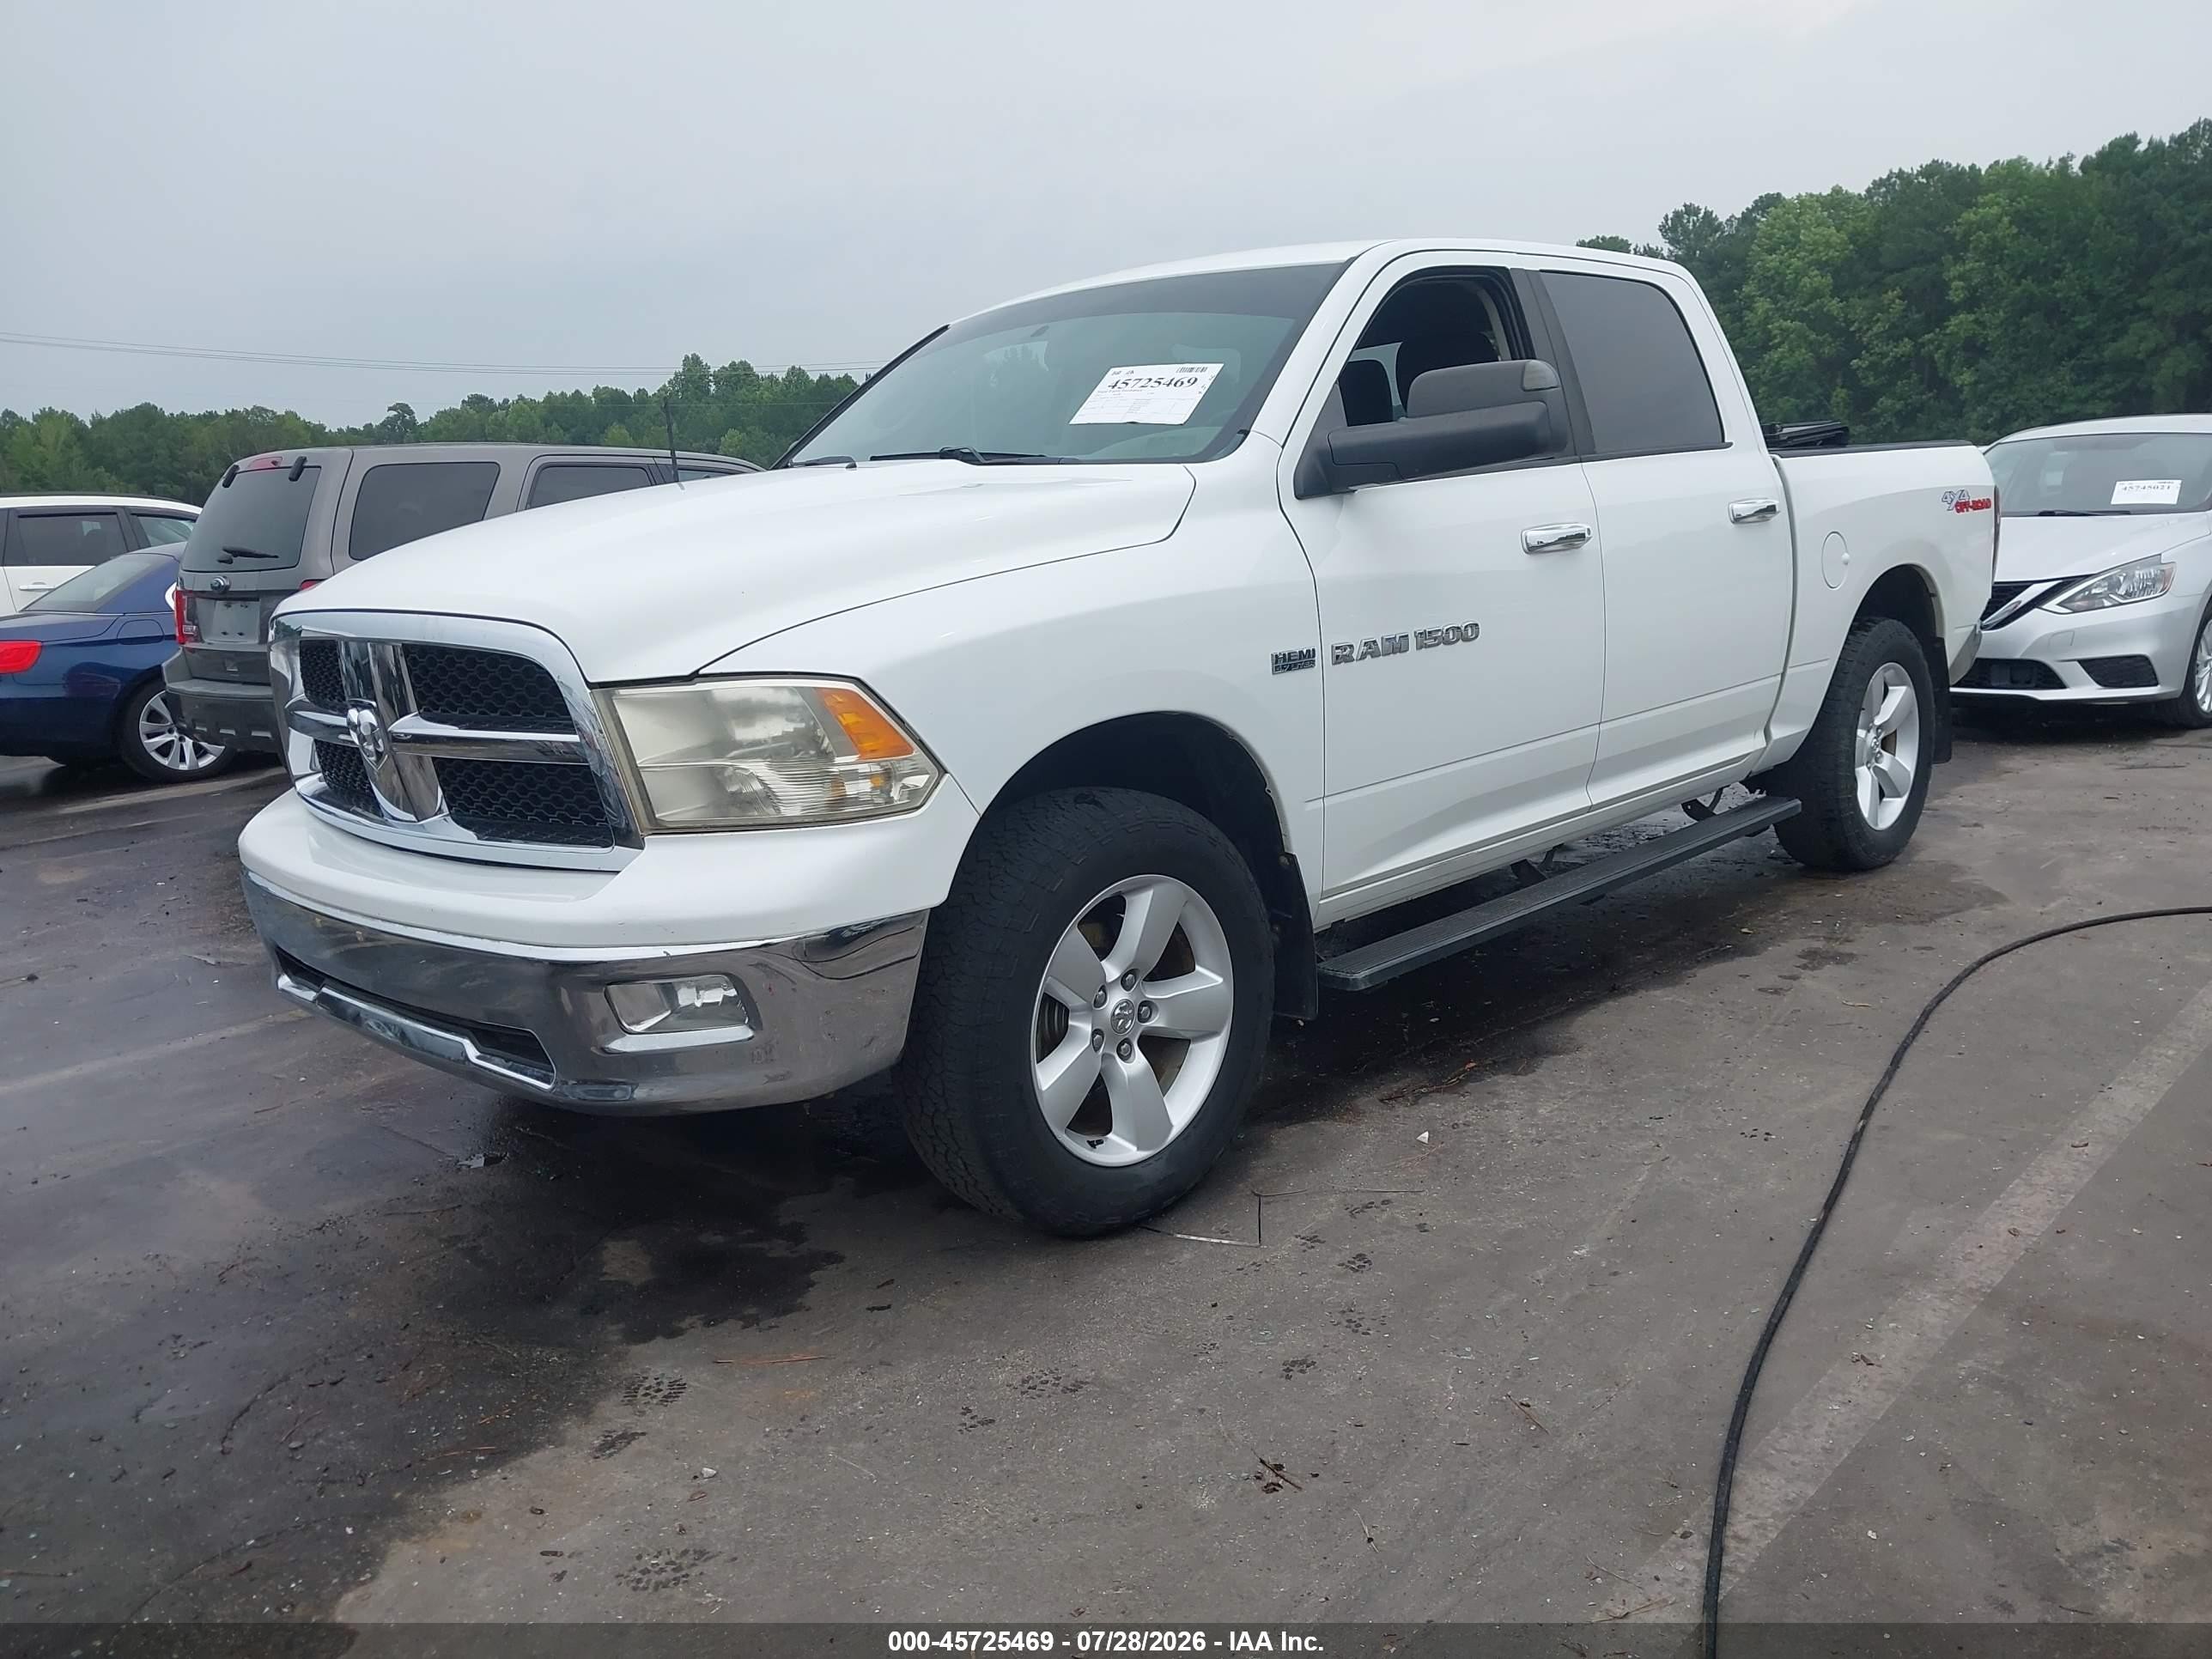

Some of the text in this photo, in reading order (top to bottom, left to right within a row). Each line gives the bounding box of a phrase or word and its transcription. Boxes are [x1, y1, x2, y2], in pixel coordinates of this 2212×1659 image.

[1108, 376, 1198, 389] 45725469
[1955, 498, 1992, 514] OFF-ROAD
[1331, 622, 1480, 665] RAM 1500
[1274, 647, 1316, 664] HEMI
